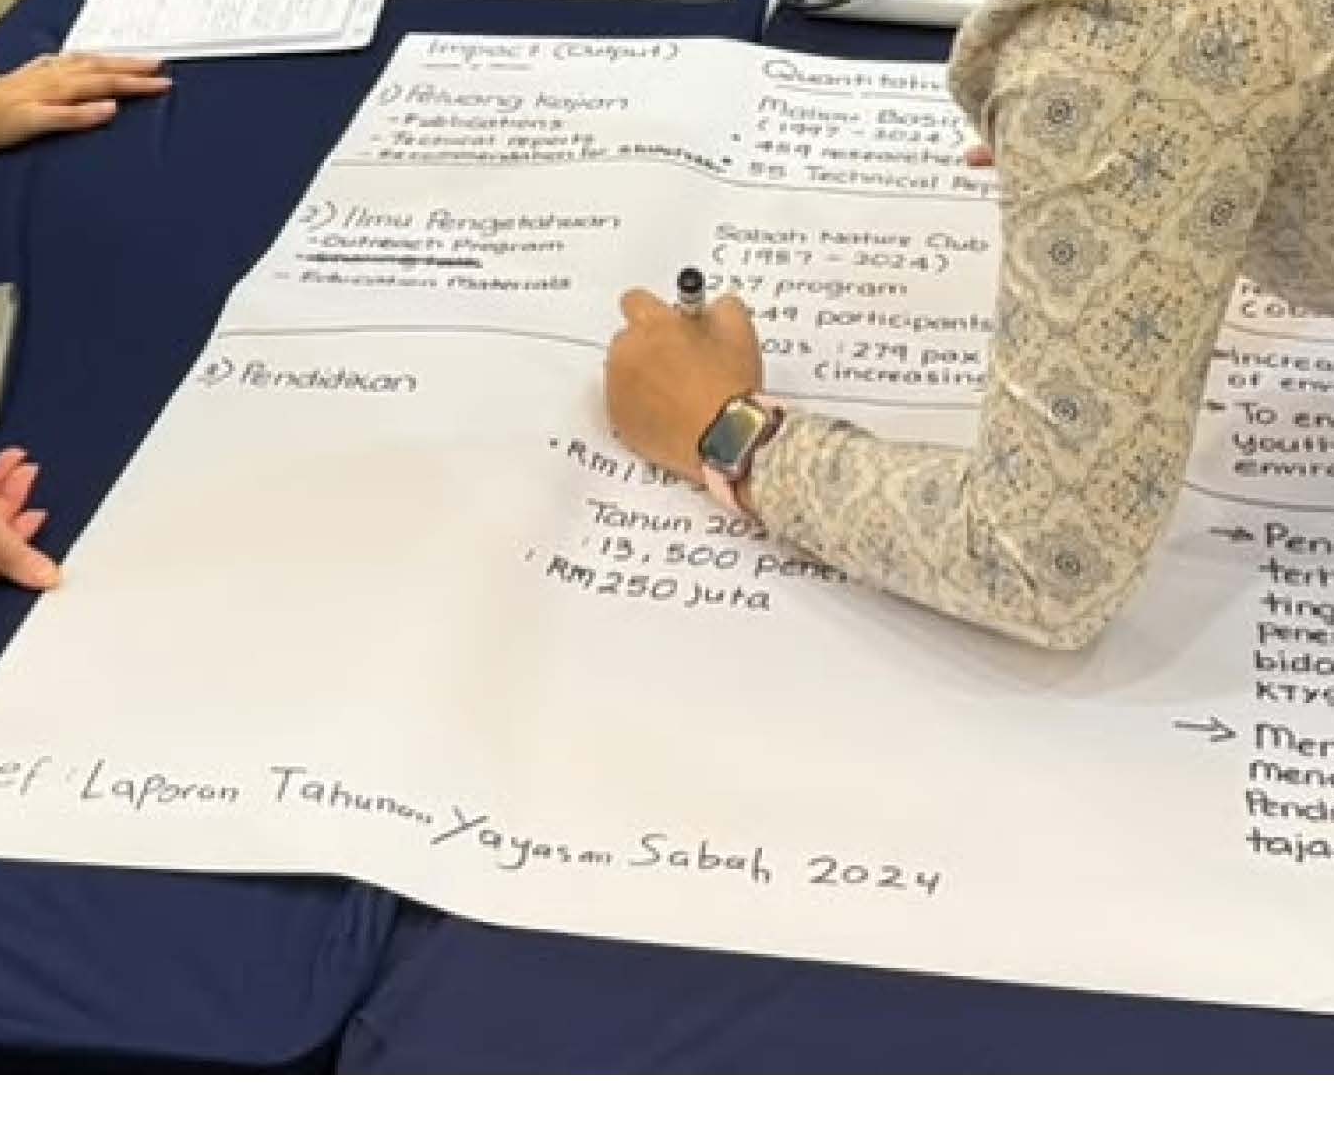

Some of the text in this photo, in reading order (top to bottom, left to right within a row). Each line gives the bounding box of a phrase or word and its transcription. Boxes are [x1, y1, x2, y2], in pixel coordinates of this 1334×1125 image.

[426, 41, 542, 63] Impact
[762, 59, 942, 90] Quantitativ
[407, 85, 524, 112] Peluang
[821, 146, 964, 165] researcher
[805, 165, 939, 189] Technical
[425, 207, 621, 235] Pengetahuan
[716, 224, 989, 252] Sabah Nature Club
[776, 278, 908, 300] program
[921, 348, 981, 367] pax
[241, 359, 418, 393] Pendidikan
[1227, 372, 1261, 389] of
[1234, 401, 1279, 426] To
[684, 581, 770, 613] juta
[81, 757, 240, 811] Laporan
[628, 831, 771, 885] Sabah
[807, 853, 940, 896] 2024
